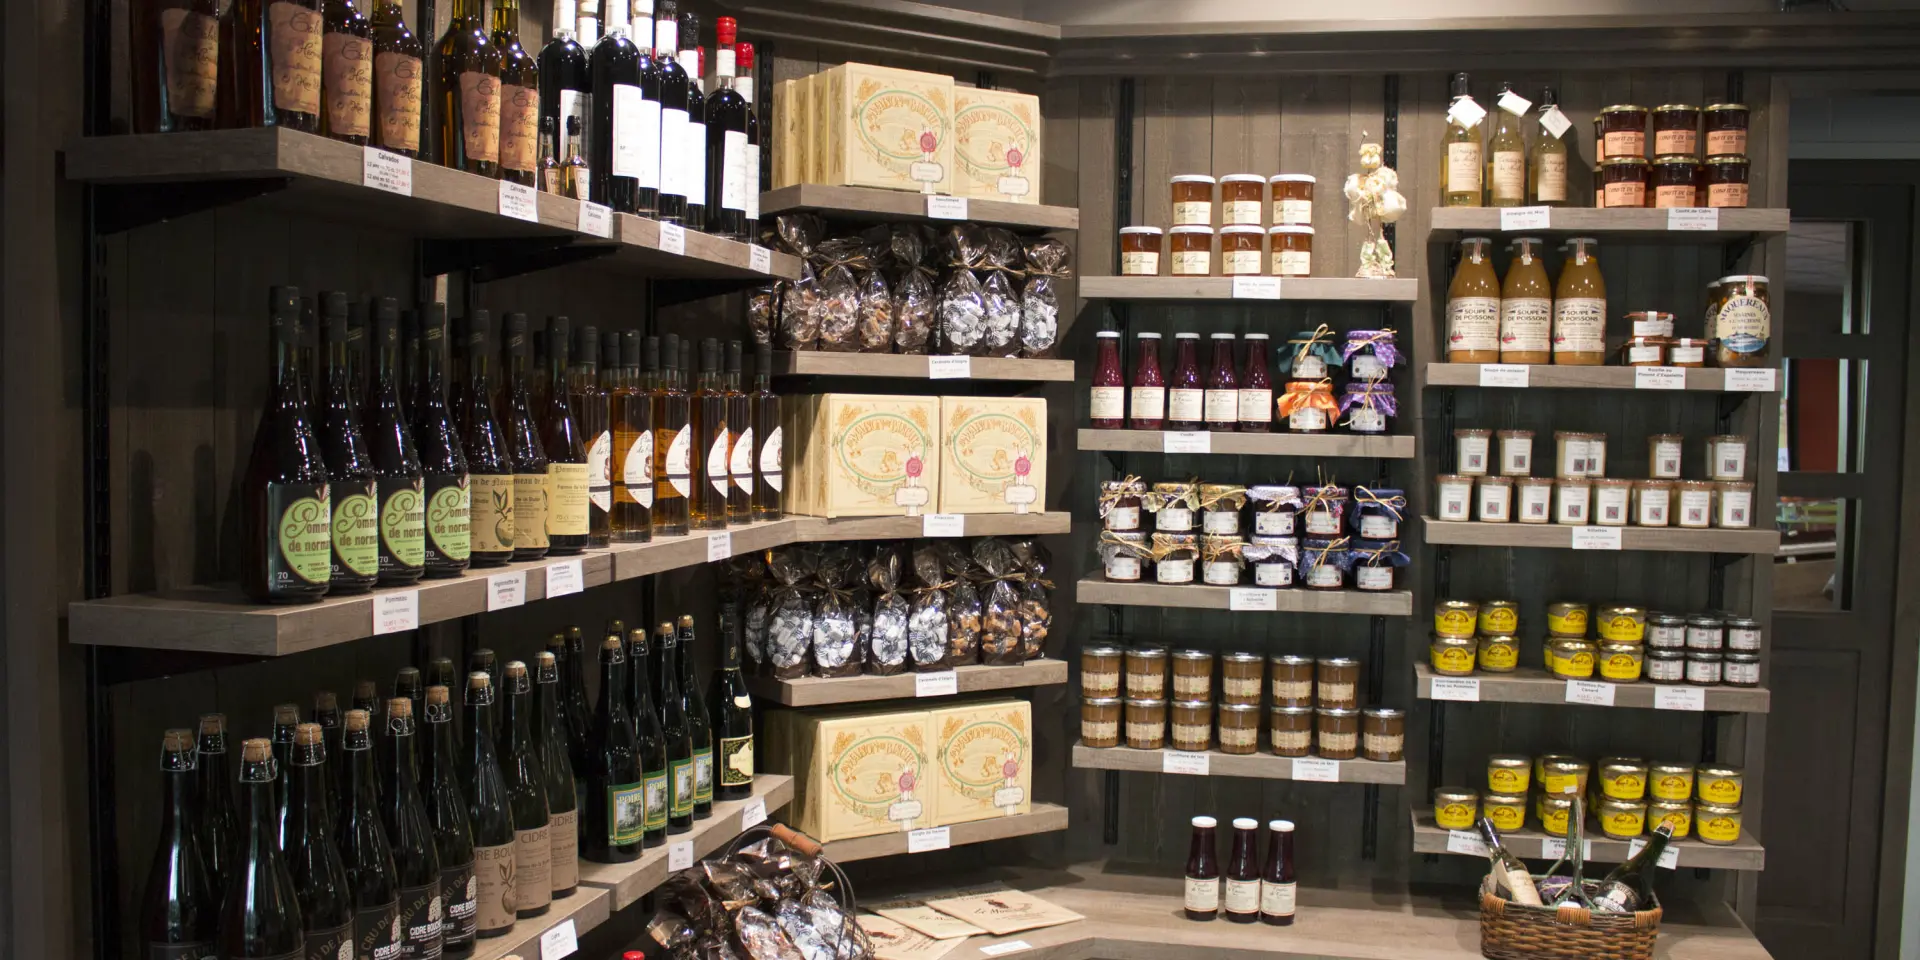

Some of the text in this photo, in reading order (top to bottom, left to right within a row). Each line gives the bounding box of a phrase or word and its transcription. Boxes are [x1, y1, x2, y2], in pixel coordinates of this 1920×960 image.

[378, 152, 400, 164] Calvados
[1721, 298, 1769, 321] MAQUEREAUX
[389, 527, 401, 539] de
[434, 524, 446, 534] de
[288, 540, 302, 552] de
[340, 534, 352, 546] de
[277, 571, 288, 580] 70
[520, 829, 548, 844] CIDRE
[450, 901, 465, 914] CIDRE
[410, 924, 426, 936] CIDRE
